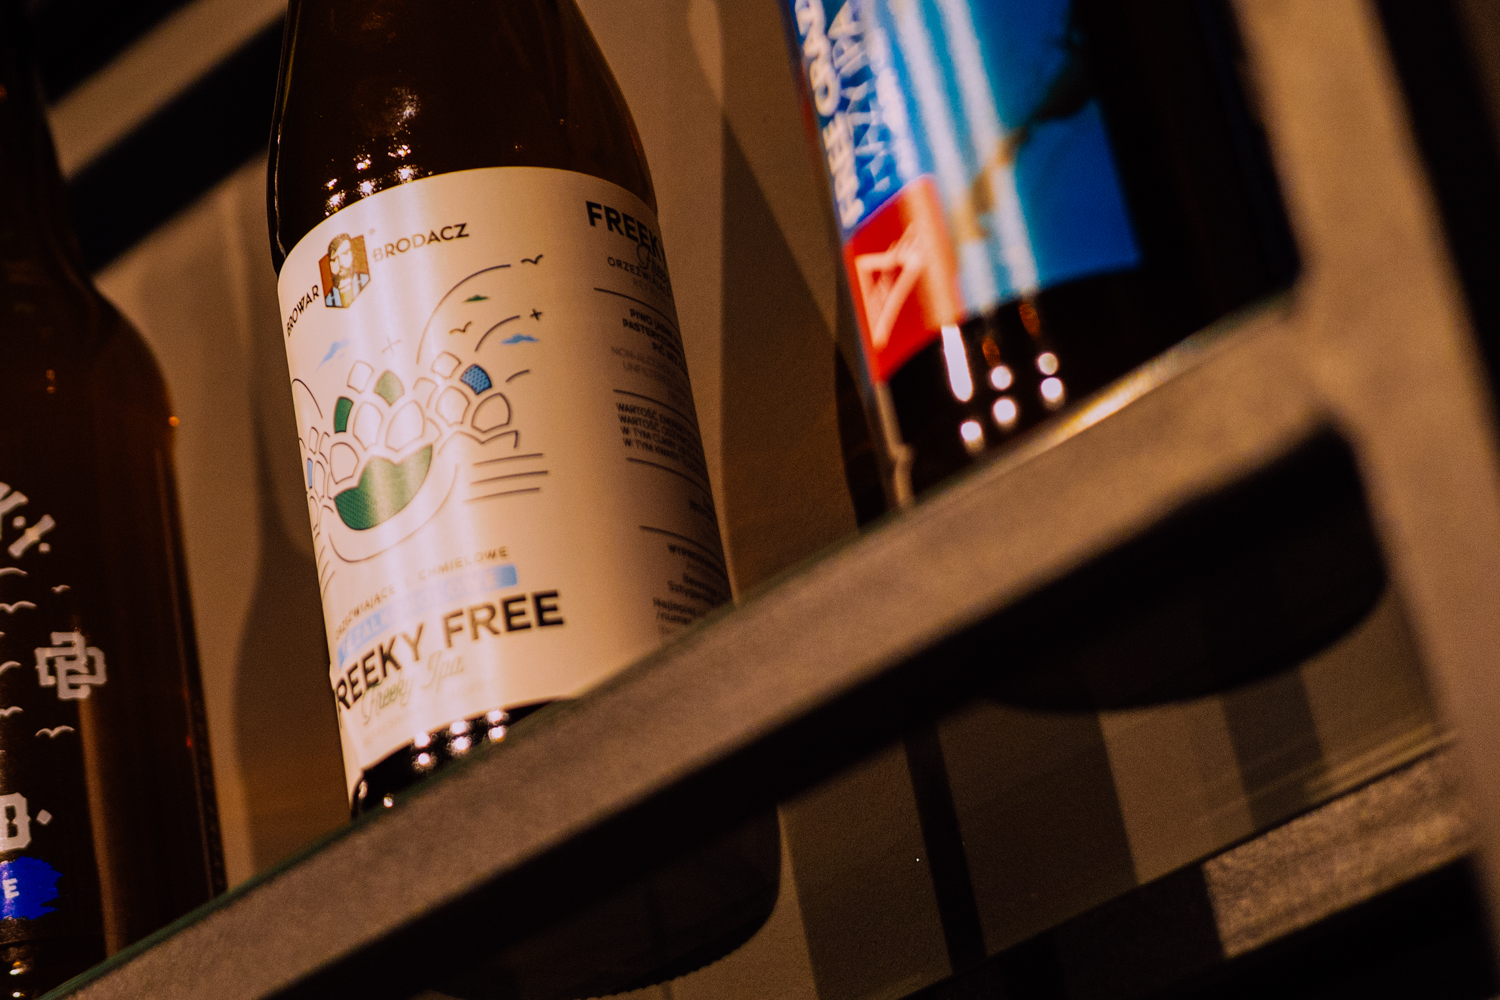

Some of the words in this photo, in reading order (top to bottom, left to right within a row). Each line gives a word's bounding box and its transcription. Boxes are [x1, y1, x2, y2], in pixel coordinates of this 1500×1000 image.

[372, 222, 469, 262] BRODACZ
[335, 621, 425, 713] REEKY
[442, 589, 565, 650] FREE
